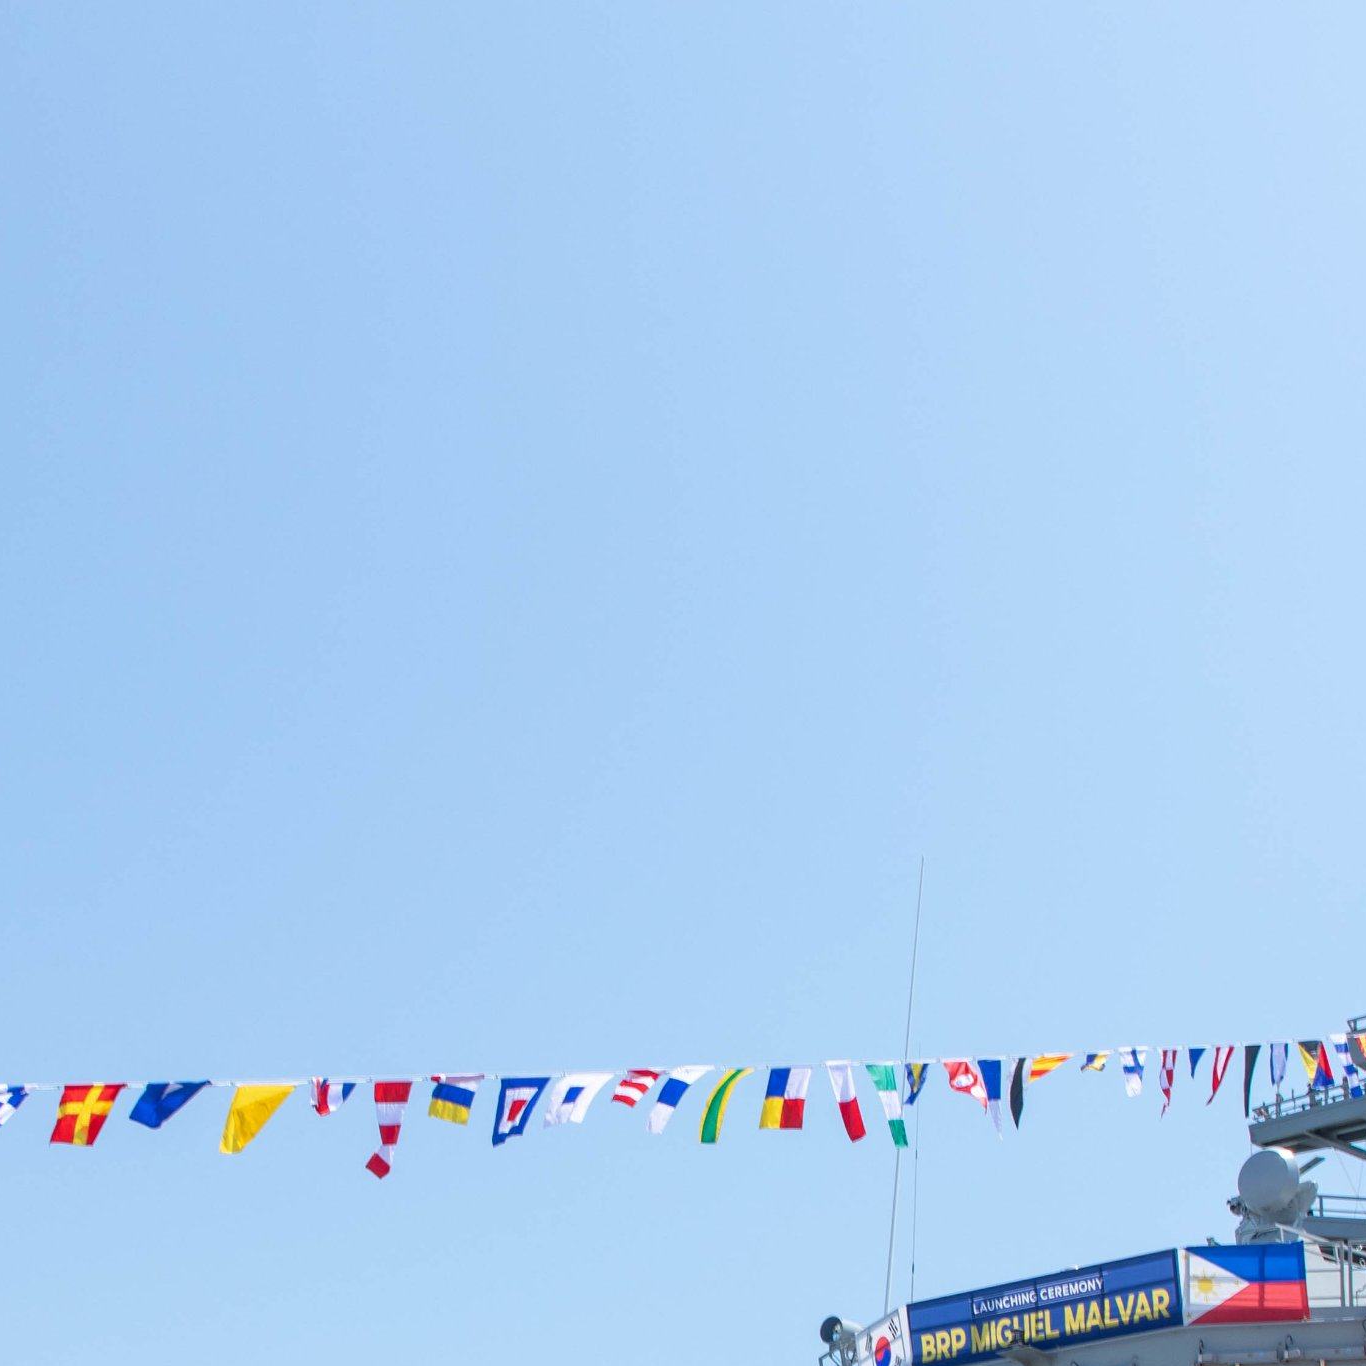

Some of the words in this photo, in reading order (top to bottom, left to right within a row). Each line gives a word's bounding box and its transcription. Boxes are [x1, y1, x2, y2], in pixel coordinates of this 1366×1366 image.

[973, 1290, 1037, 1315] LAUNCHING
[1040, 1277, 1103, 1301] CEREMONY
[921, 1327, 966, 1364] BRP
[971, 1309, 1059, 1355] MIGUEL
[1064, 1287, 1170, 1336] MALVAR
